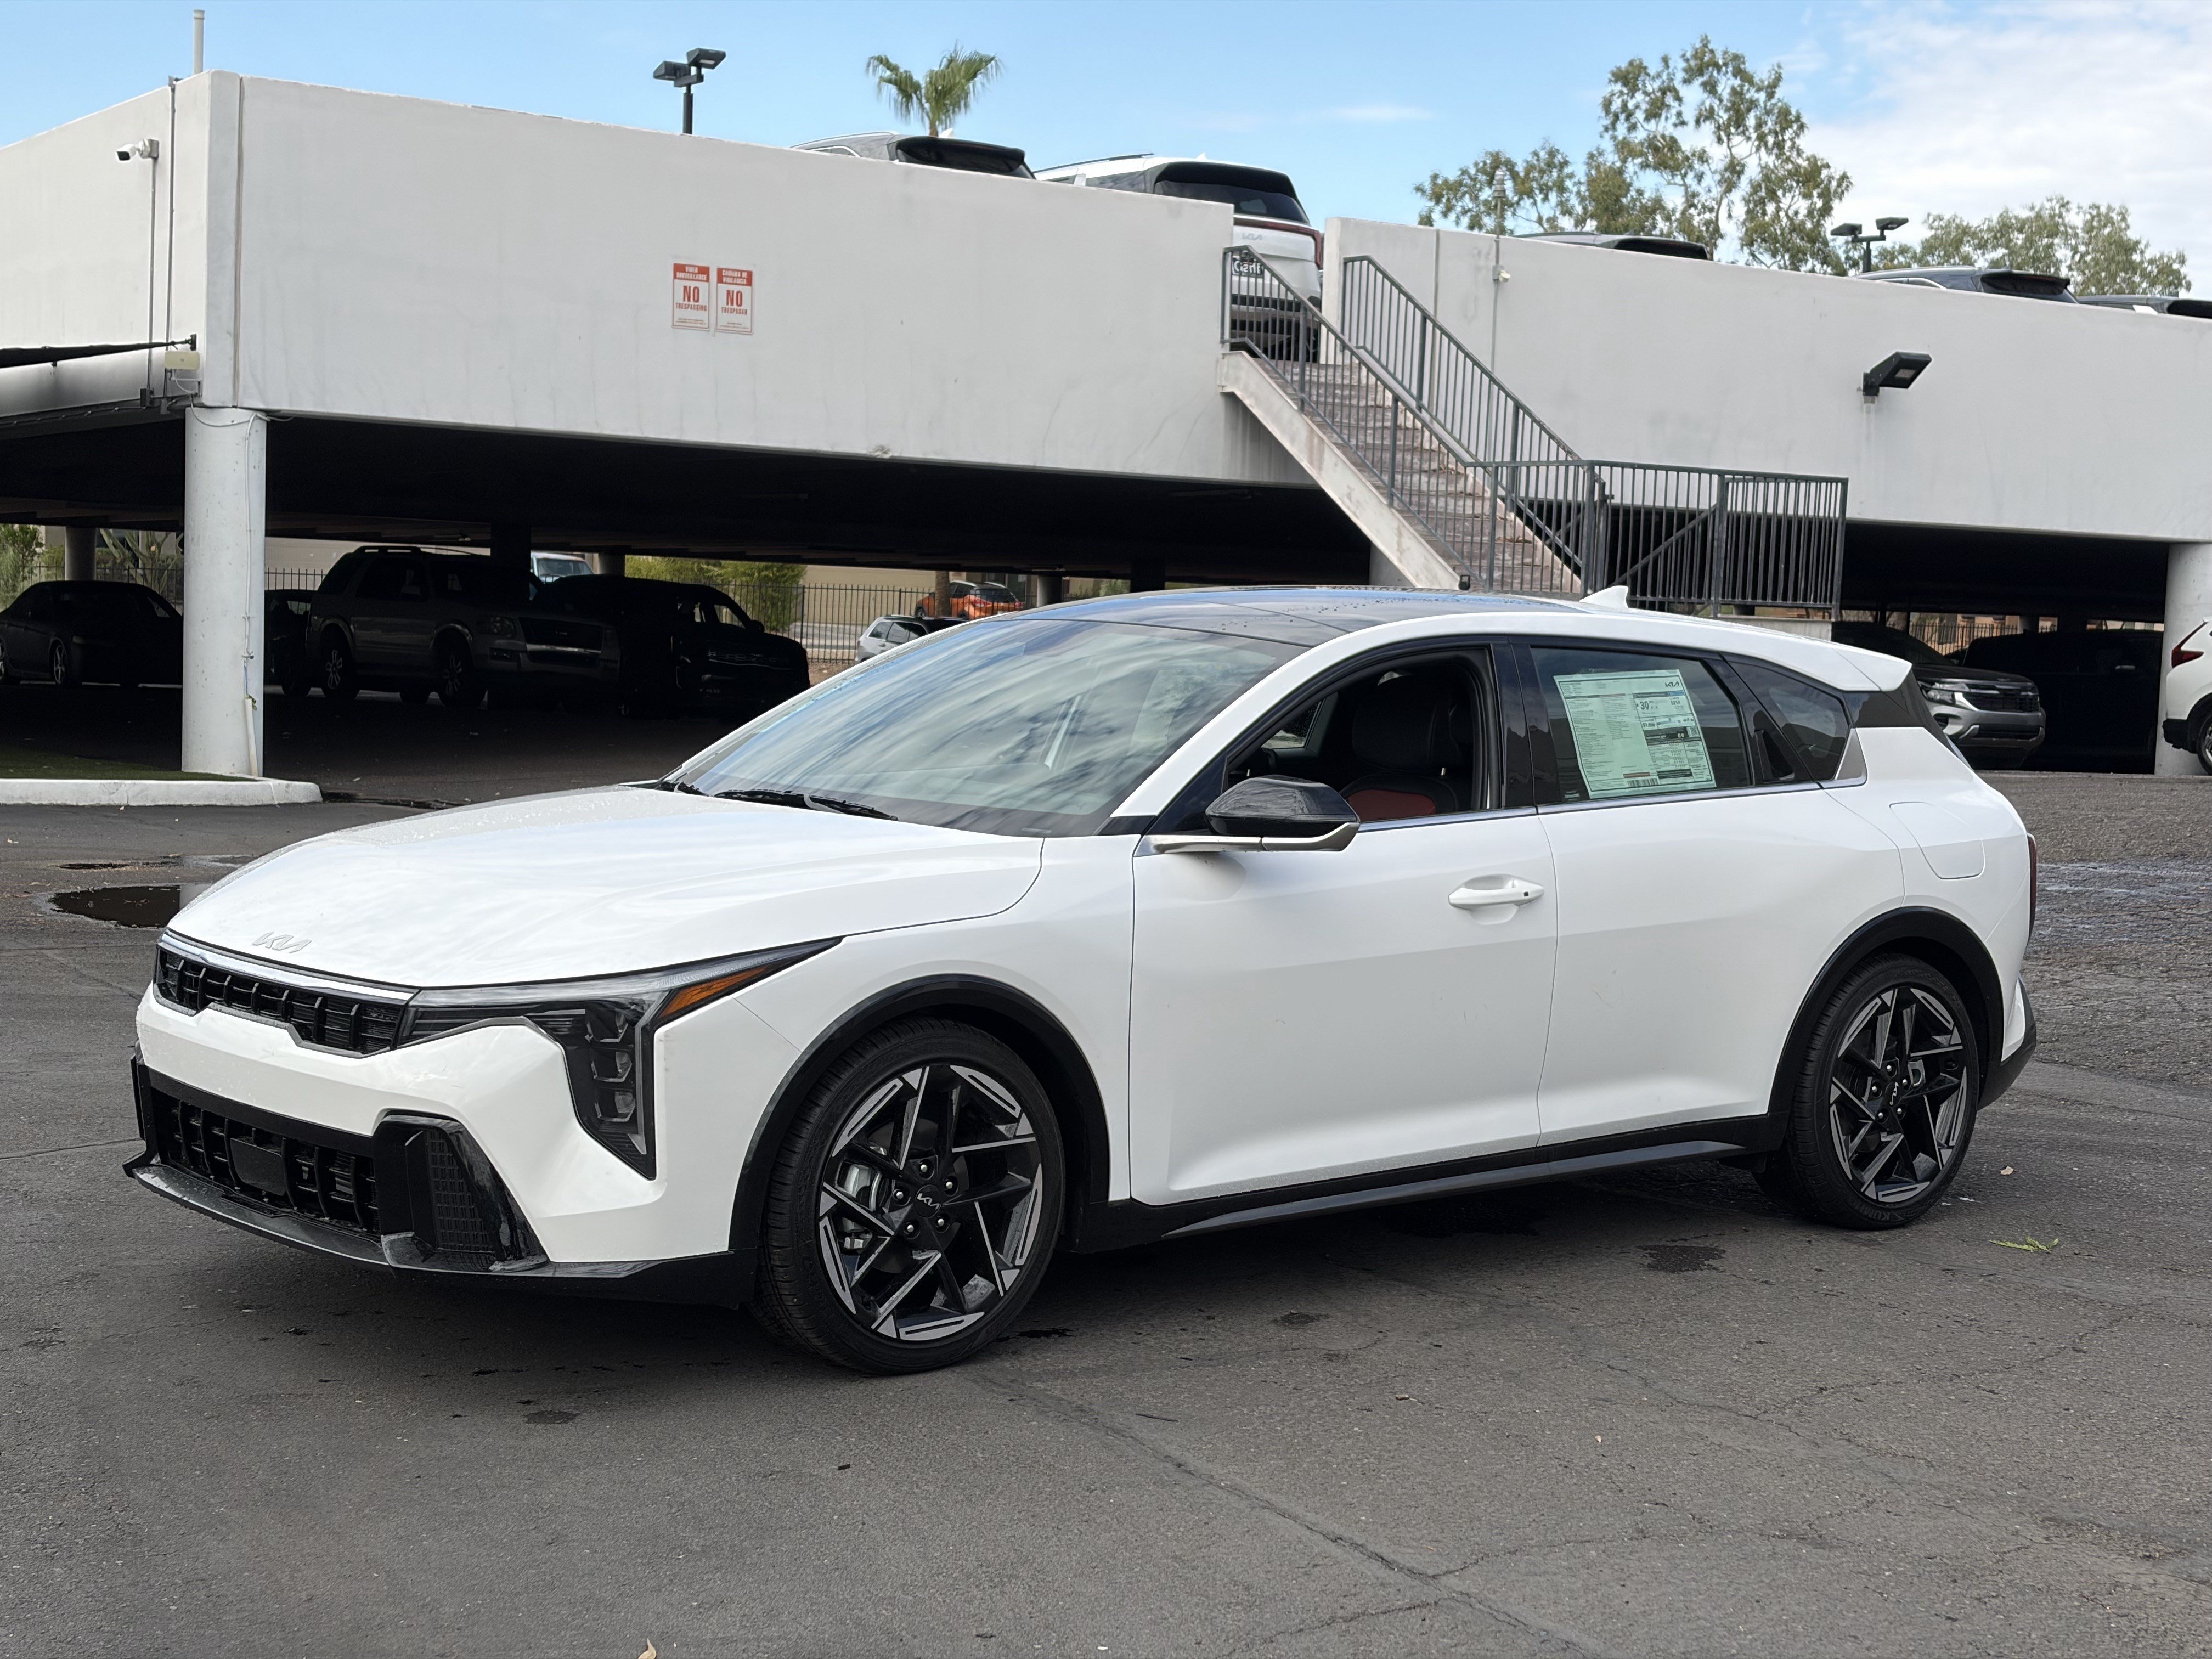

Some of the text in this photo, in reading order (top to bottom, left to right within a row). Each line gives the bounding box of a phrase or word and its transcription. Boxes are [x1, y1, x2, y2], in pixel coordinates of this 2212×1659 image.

[683, 285, 700, 303] NO
[726, 290, 743, 307] NO
[675, 303, 707, 312] TRESPASSING
[1640, 701, 1650, 710] 30
[251, 932, 312, 954] KIA
[917, 1193, 940, 1210] KIA
